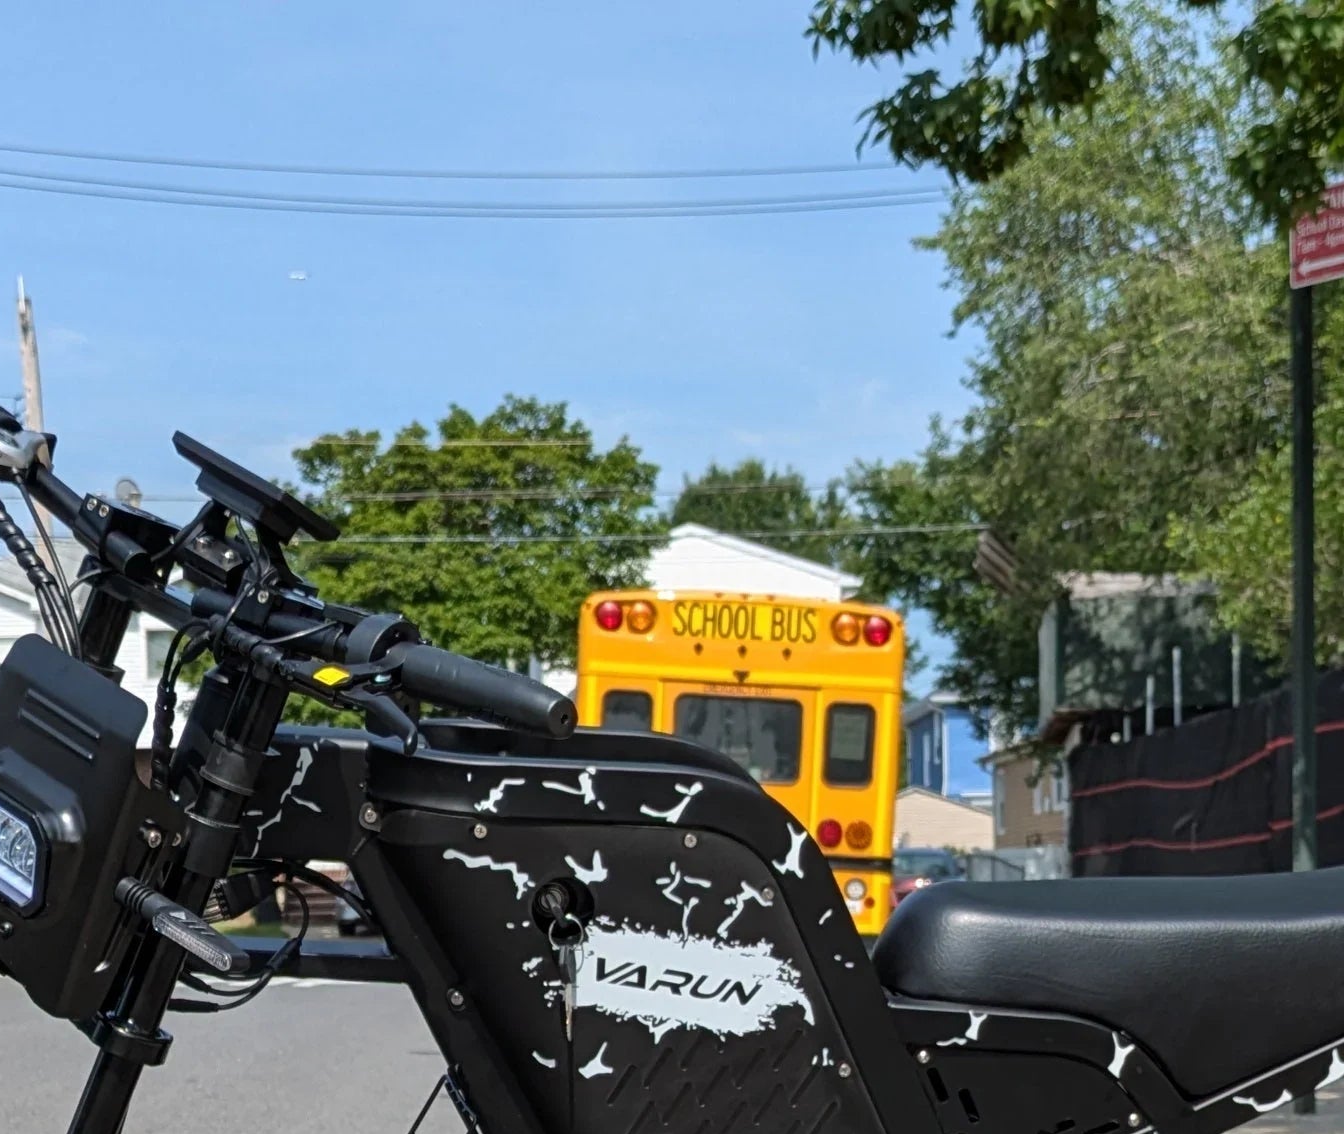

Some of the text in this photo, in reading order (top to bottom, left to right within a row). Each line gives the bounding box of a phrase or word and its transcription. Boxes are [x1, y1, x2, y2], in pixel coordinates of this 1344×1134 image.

[672, 601, 818, 644] SCHOOL BUS
[596, 957, 763, 1006] VARUN
